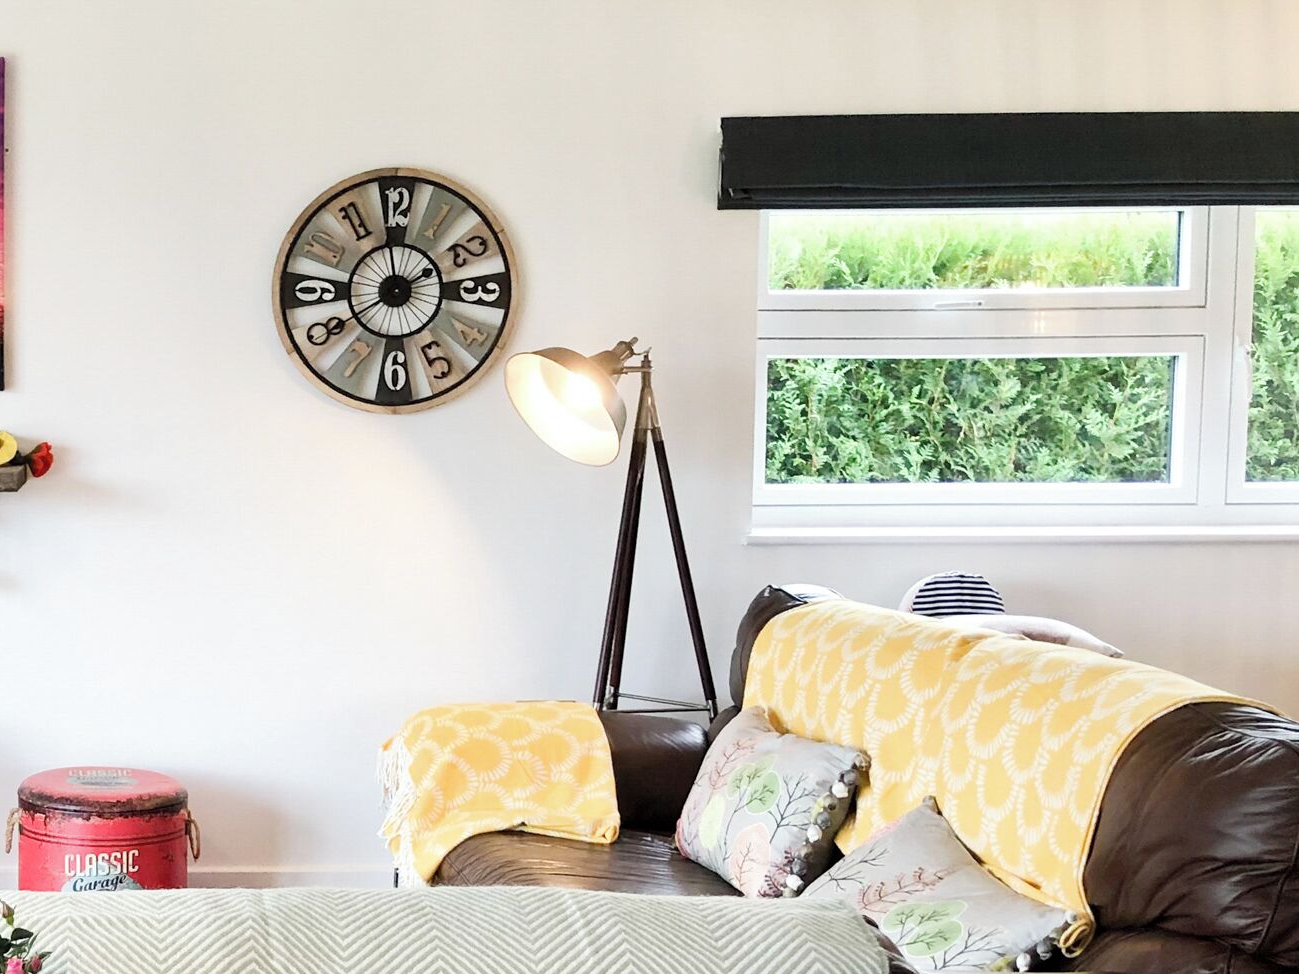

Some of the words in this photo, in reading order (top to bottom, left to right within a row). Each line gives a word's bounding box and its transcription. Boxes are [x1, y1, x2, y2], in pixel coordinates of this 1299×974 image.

[339, 202, 372, 241] 11
[385, 187, 410, 227] 12
[423, 203, 452, 239] 1
[447, 235, 487, 267] 2
[295, 279, 335, 301] 9
[459, 280, 500, 302] 3
[307, 316, 345, 345] 8
[453, 320, 488, 345] 4
[344, 339, 373, 378] 7
[384, 351, 406, 391] 6
[421, 340, 451, 379] 5
[64, 850, 139, 877] CLASSIC
[73, 874, 126, 892] Garage
